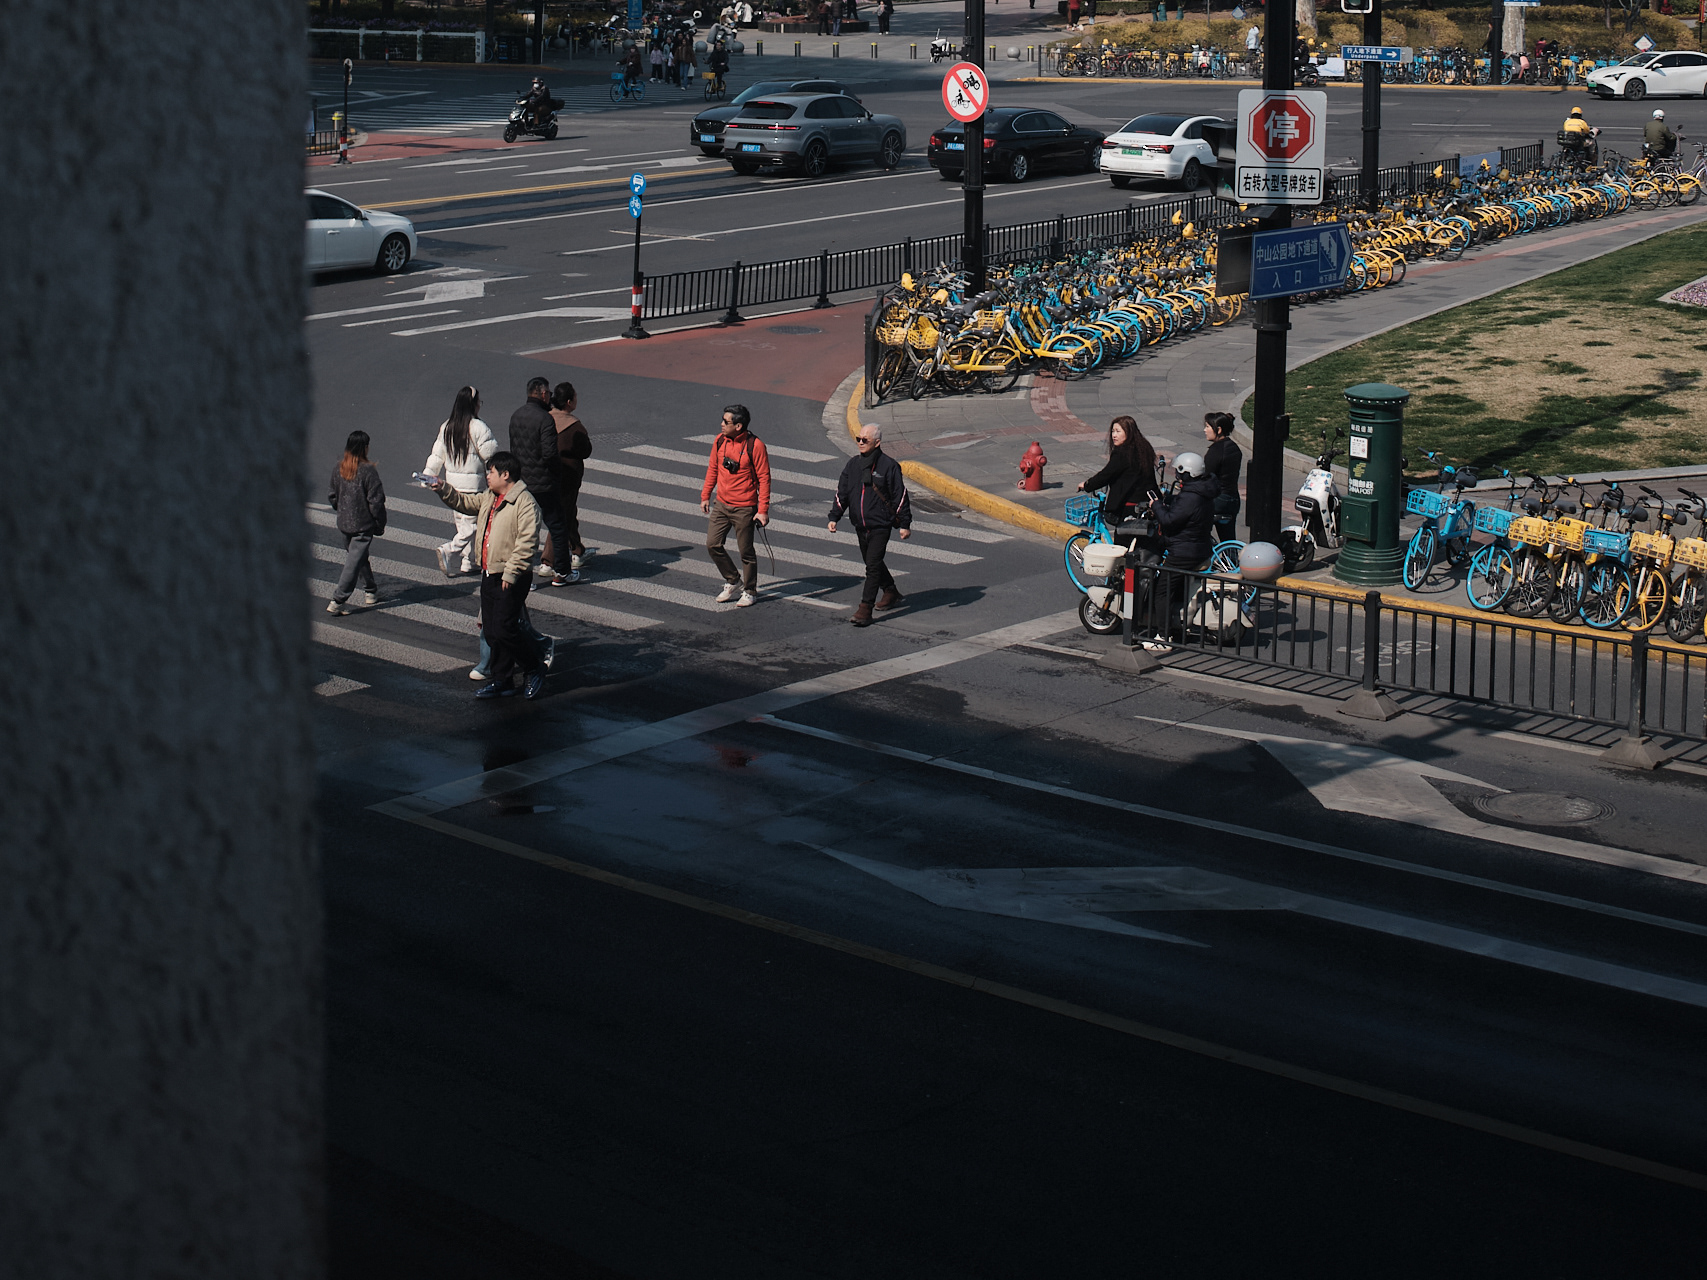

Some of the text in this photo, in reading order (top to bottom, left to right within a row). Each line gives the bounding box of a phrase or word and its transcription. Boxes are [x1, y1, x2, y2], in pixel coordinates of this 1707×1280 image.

[1264, 110, 1299, 148] 停
[1243, 173, 1316, 193] 右转大型号牌货车
[1256, 238, 1318, 264] 中山公园地下通道
